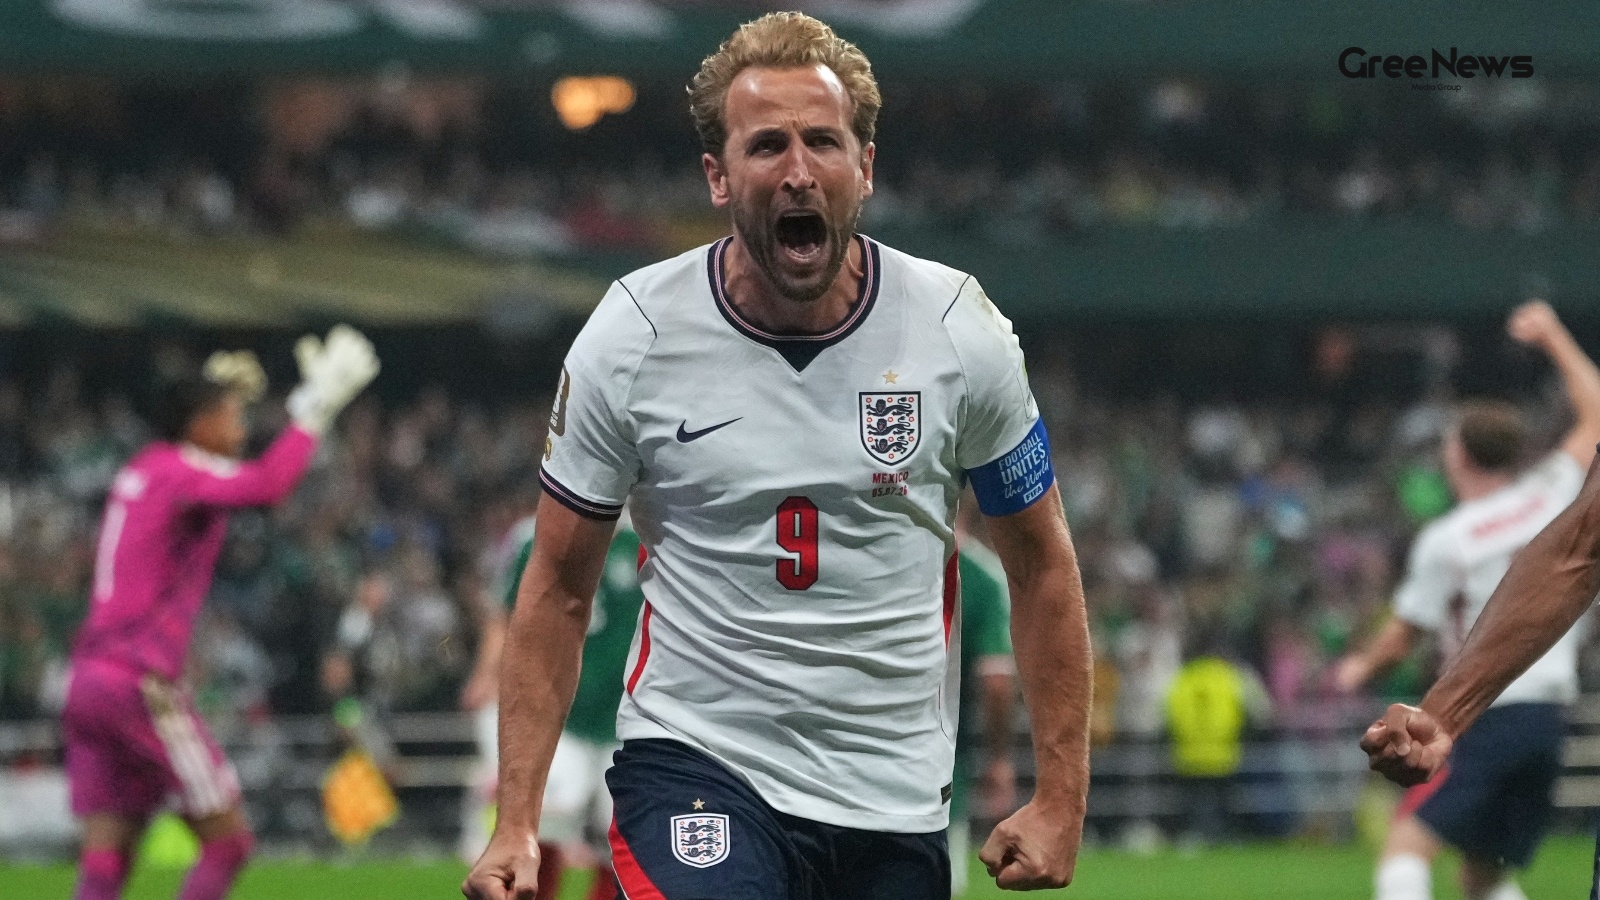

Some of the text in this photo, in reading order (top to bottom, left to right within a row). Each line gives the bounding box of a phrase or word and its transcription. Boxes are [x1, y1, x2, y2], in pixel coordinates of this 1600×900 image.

[998, 432, 1041, 471] FOOTBALL
[1001, 442, 1046, 485] UNITES
[872, 471, 909, 484] MEXICO
[776, 496, 819, 590] 9
